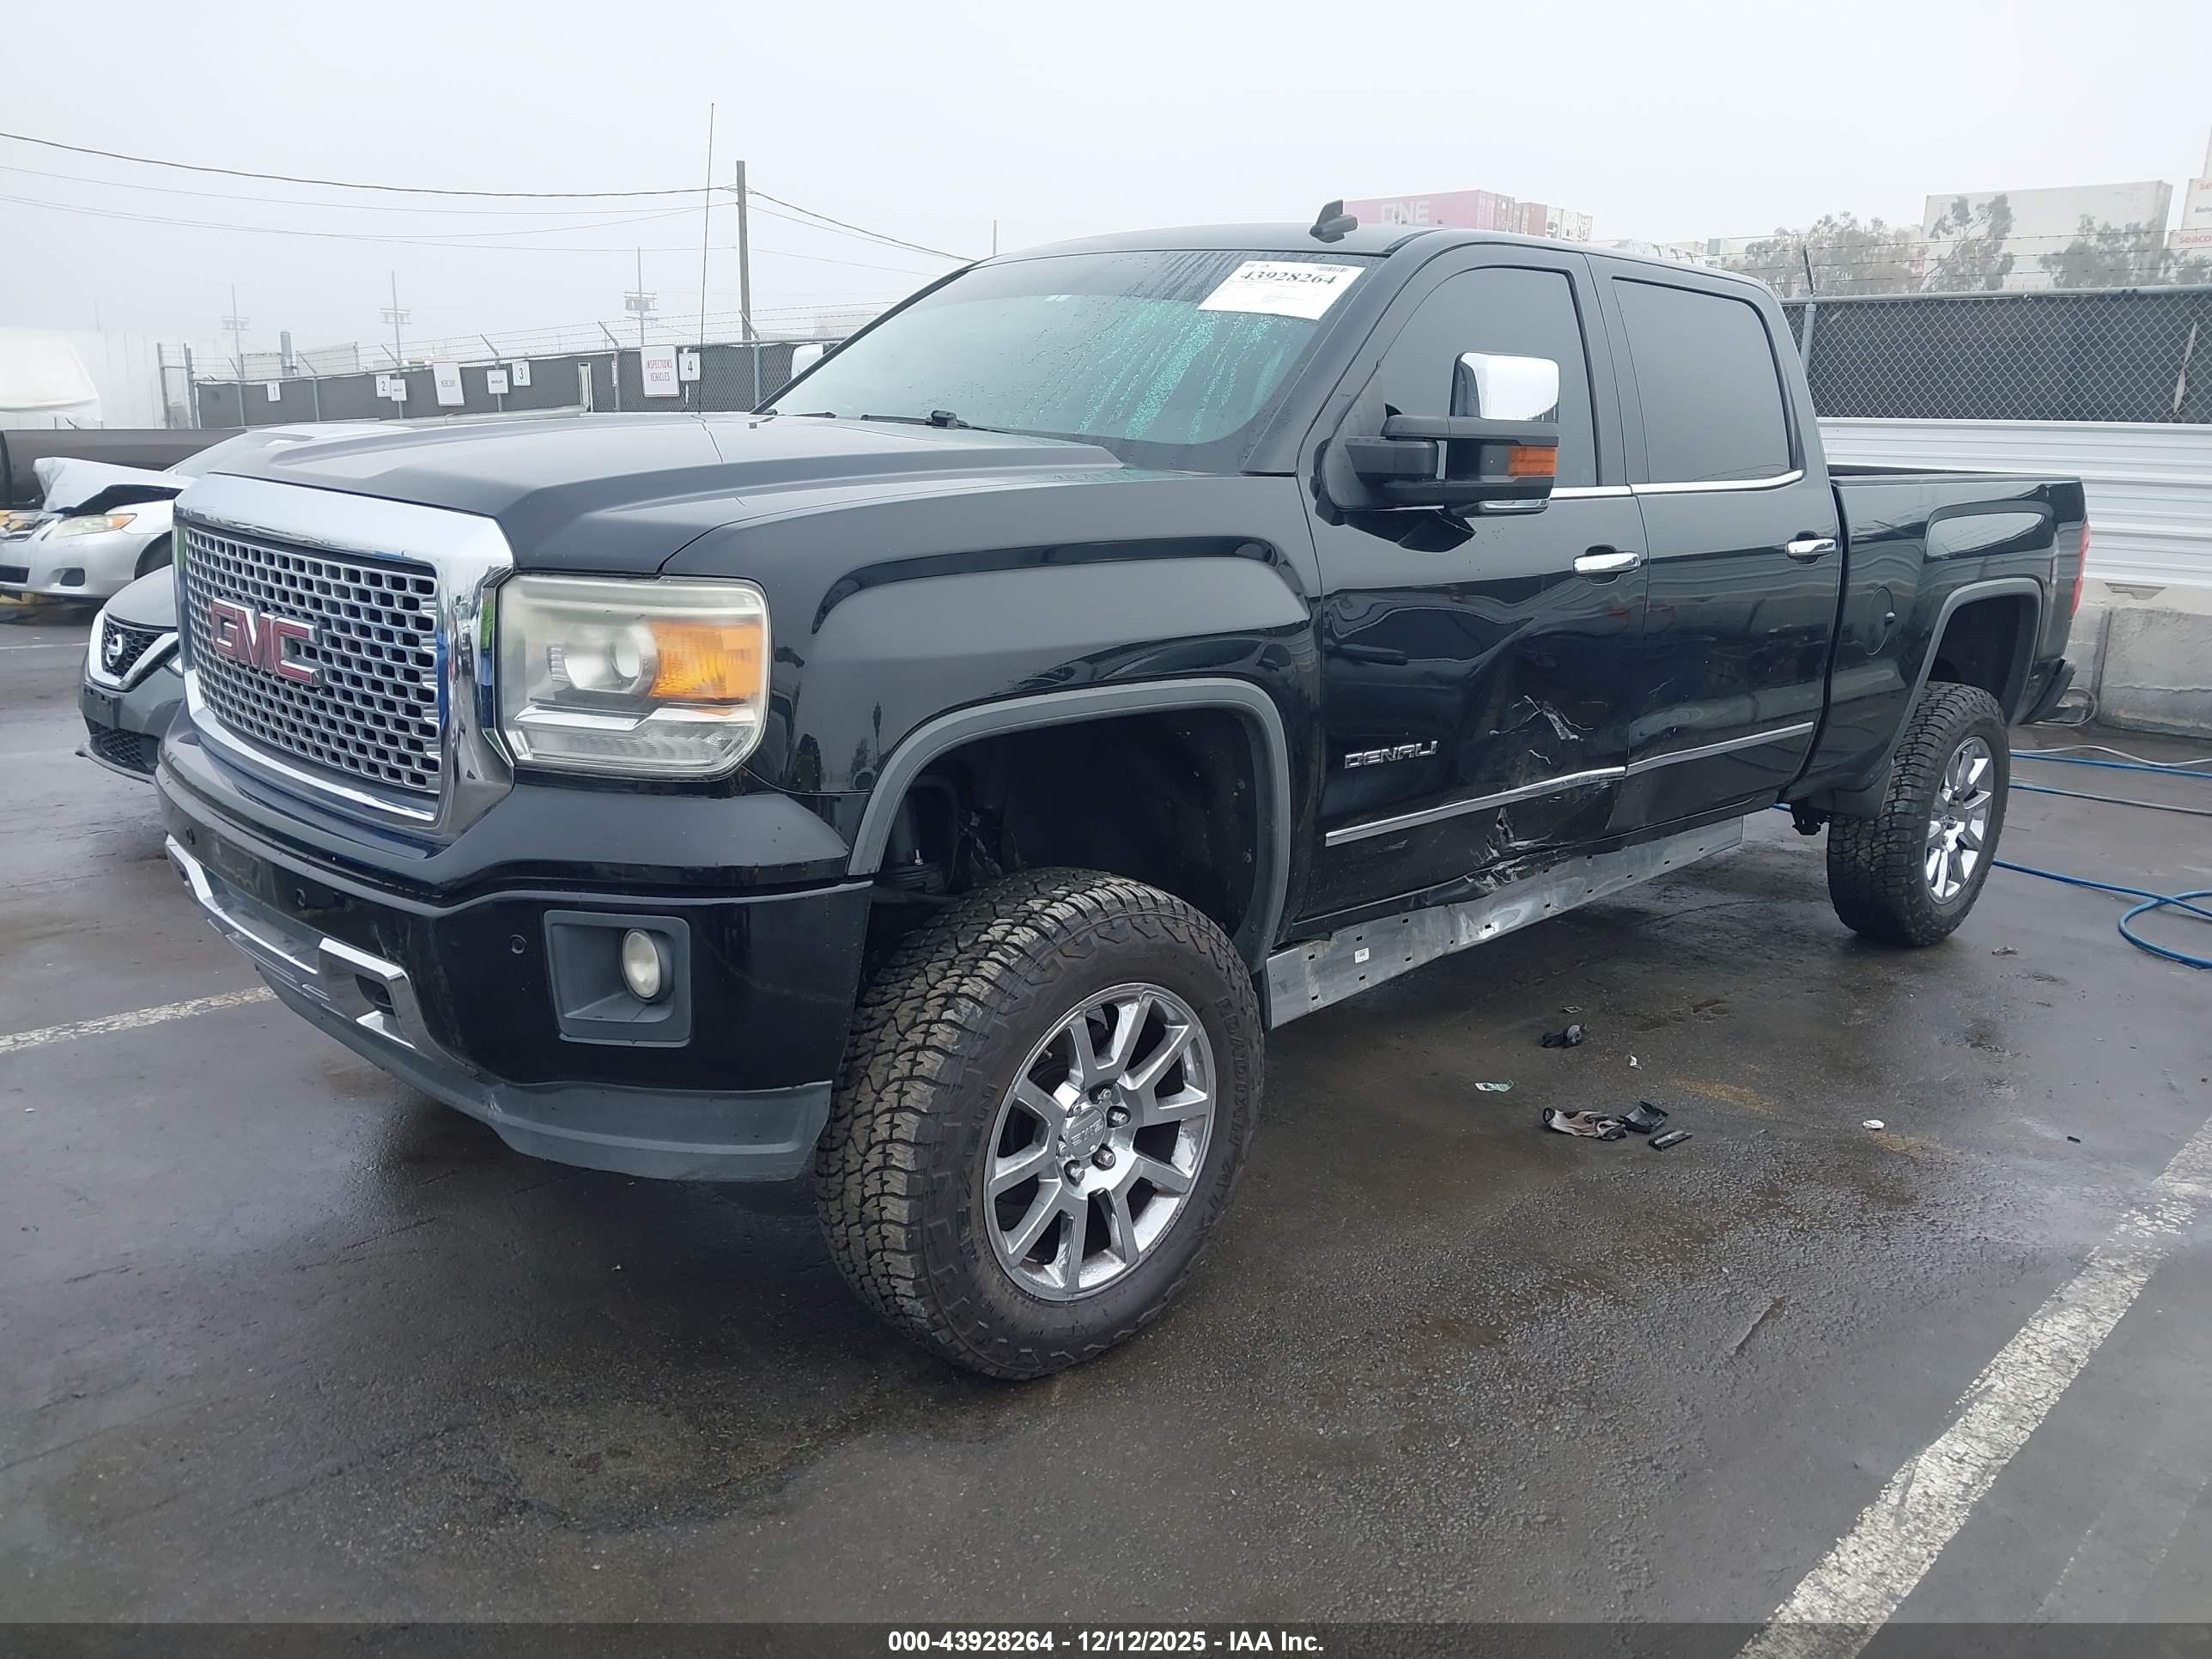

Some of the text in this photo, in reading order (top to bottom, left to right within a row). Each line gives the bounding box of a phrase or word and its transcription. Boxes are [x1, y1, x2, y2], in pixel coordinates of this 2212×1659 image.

[1381, 199, 1429, 224] ONE
[1241, 270, 1338, 285] 43928264
[518, 368, 524, 380] 3
[687, 360, 694, 376] 4
[650, 372, 671, 382] VEHICLES
[381, 380, 386, 392] 2
[210, 598, 323, 687] GMC
[1344, 739, 1438, 769] DENALI
